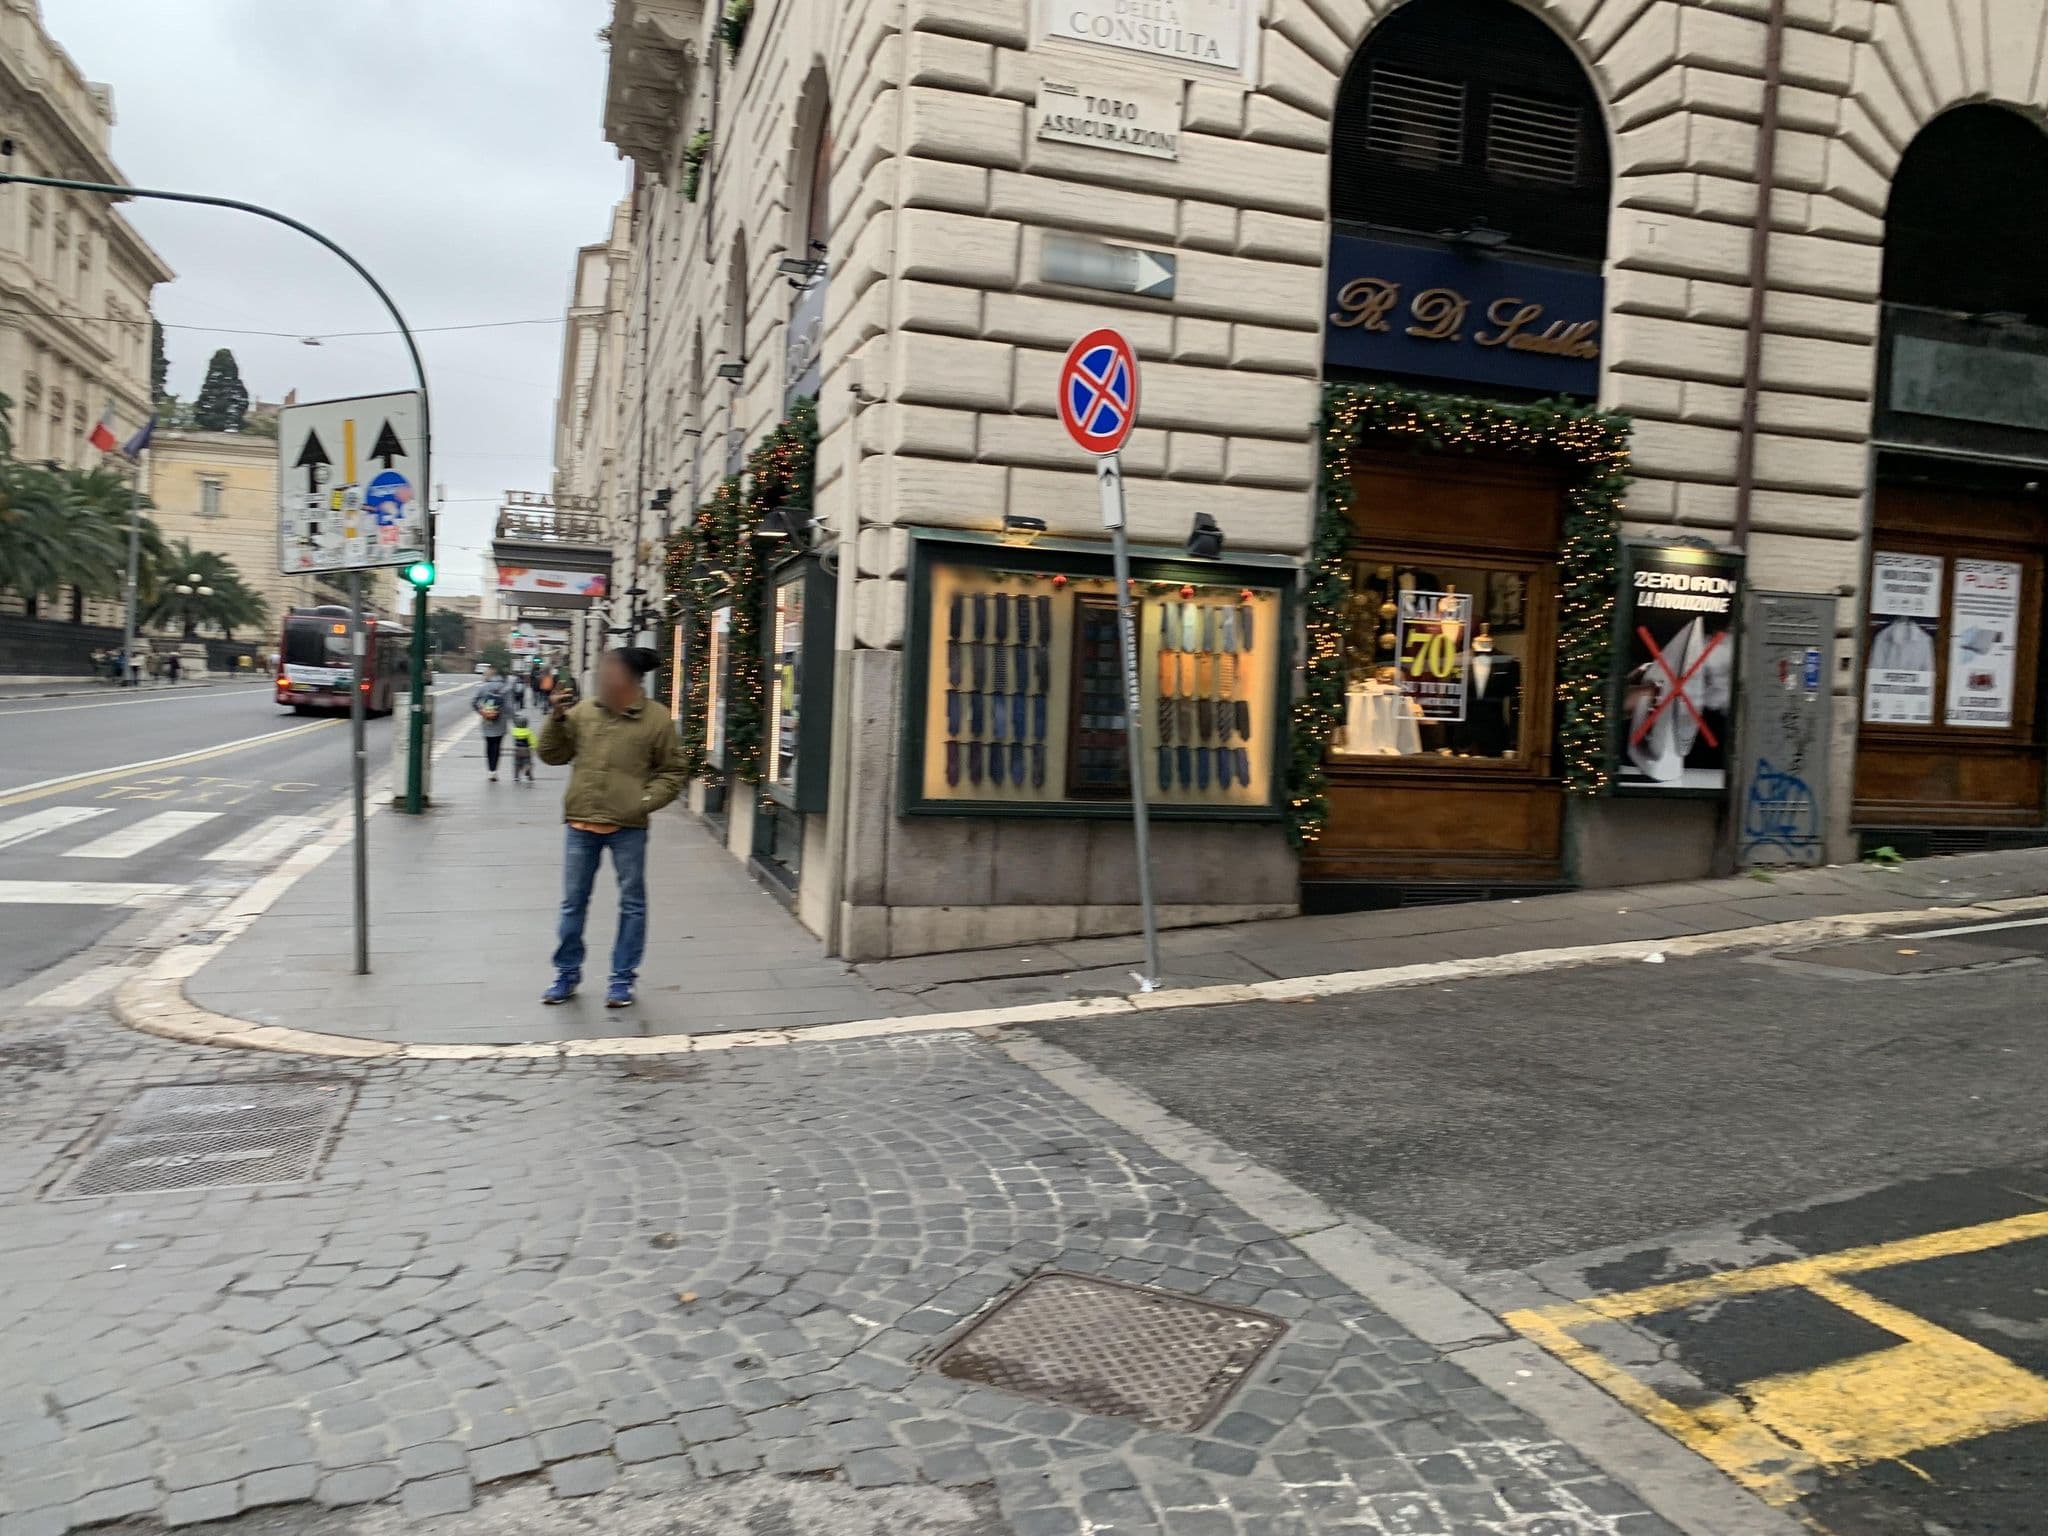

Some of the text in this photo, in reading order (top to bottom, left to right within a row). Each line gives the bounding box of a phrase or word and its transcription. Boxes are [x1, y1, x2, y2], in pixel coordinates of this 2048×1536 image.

[1069, 10, 1222, 60] CONSULTA
[1085, 95, 1139, 120] TORO
[1633, 571, 1737, 594] ZERO IRON
